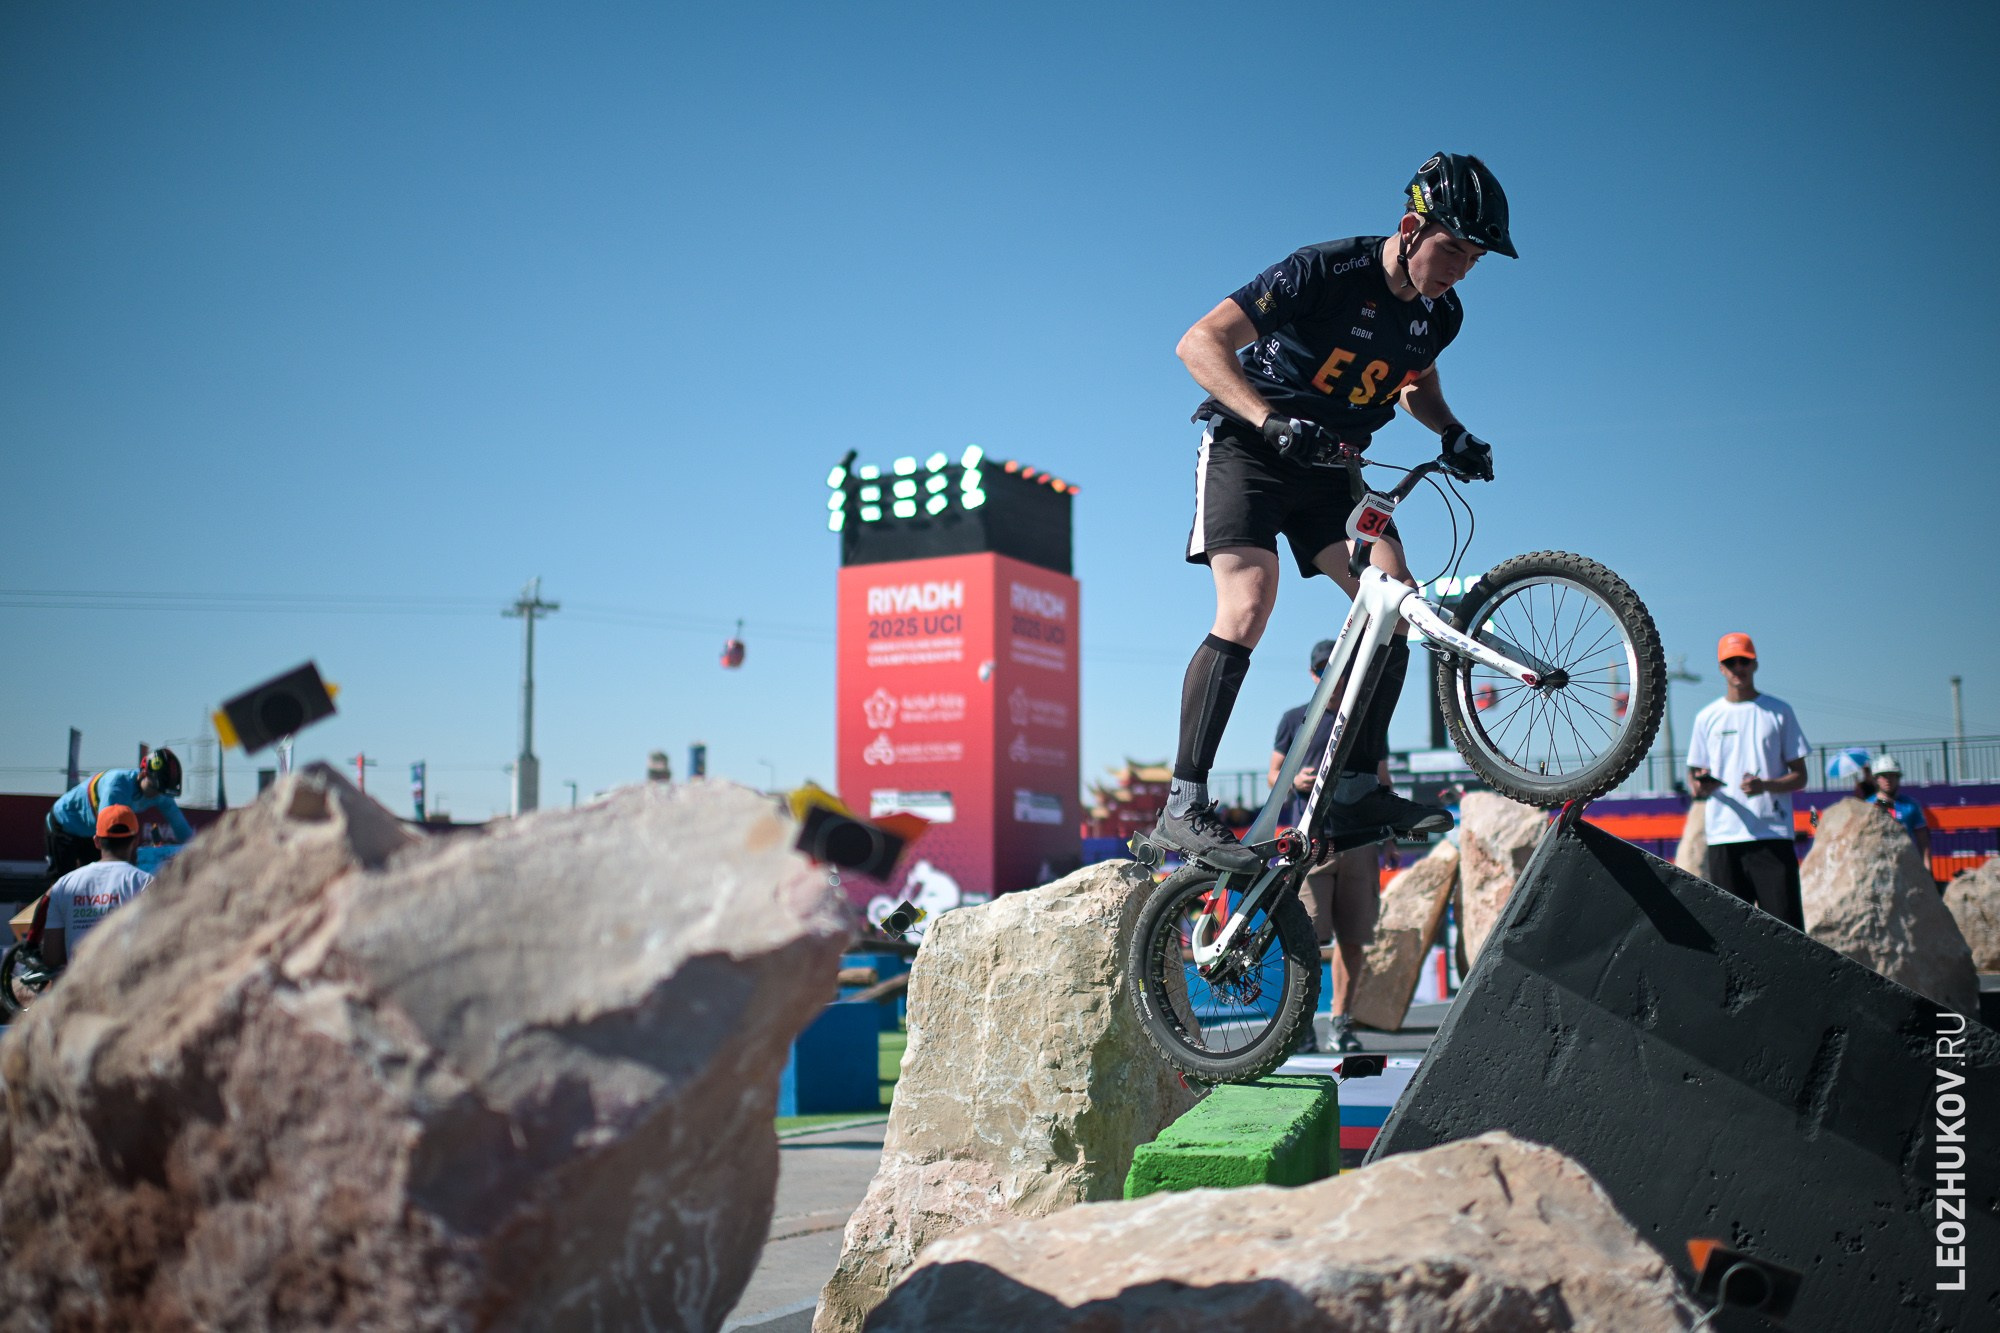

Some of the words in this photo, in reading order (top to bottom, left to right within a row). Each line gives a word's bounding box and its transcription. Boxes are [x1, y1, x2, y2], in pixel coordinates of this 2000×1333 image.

[1361, 307, 1376, 319] RFEC
[1350, 326, 1374, 340] GOBIK
[867, 580, 964, 616] RIYADH
[868, 617, 918, 639] 2025
[923, 613, 962, 635] UCI
[73, 892, 120, 907] RIYADH
